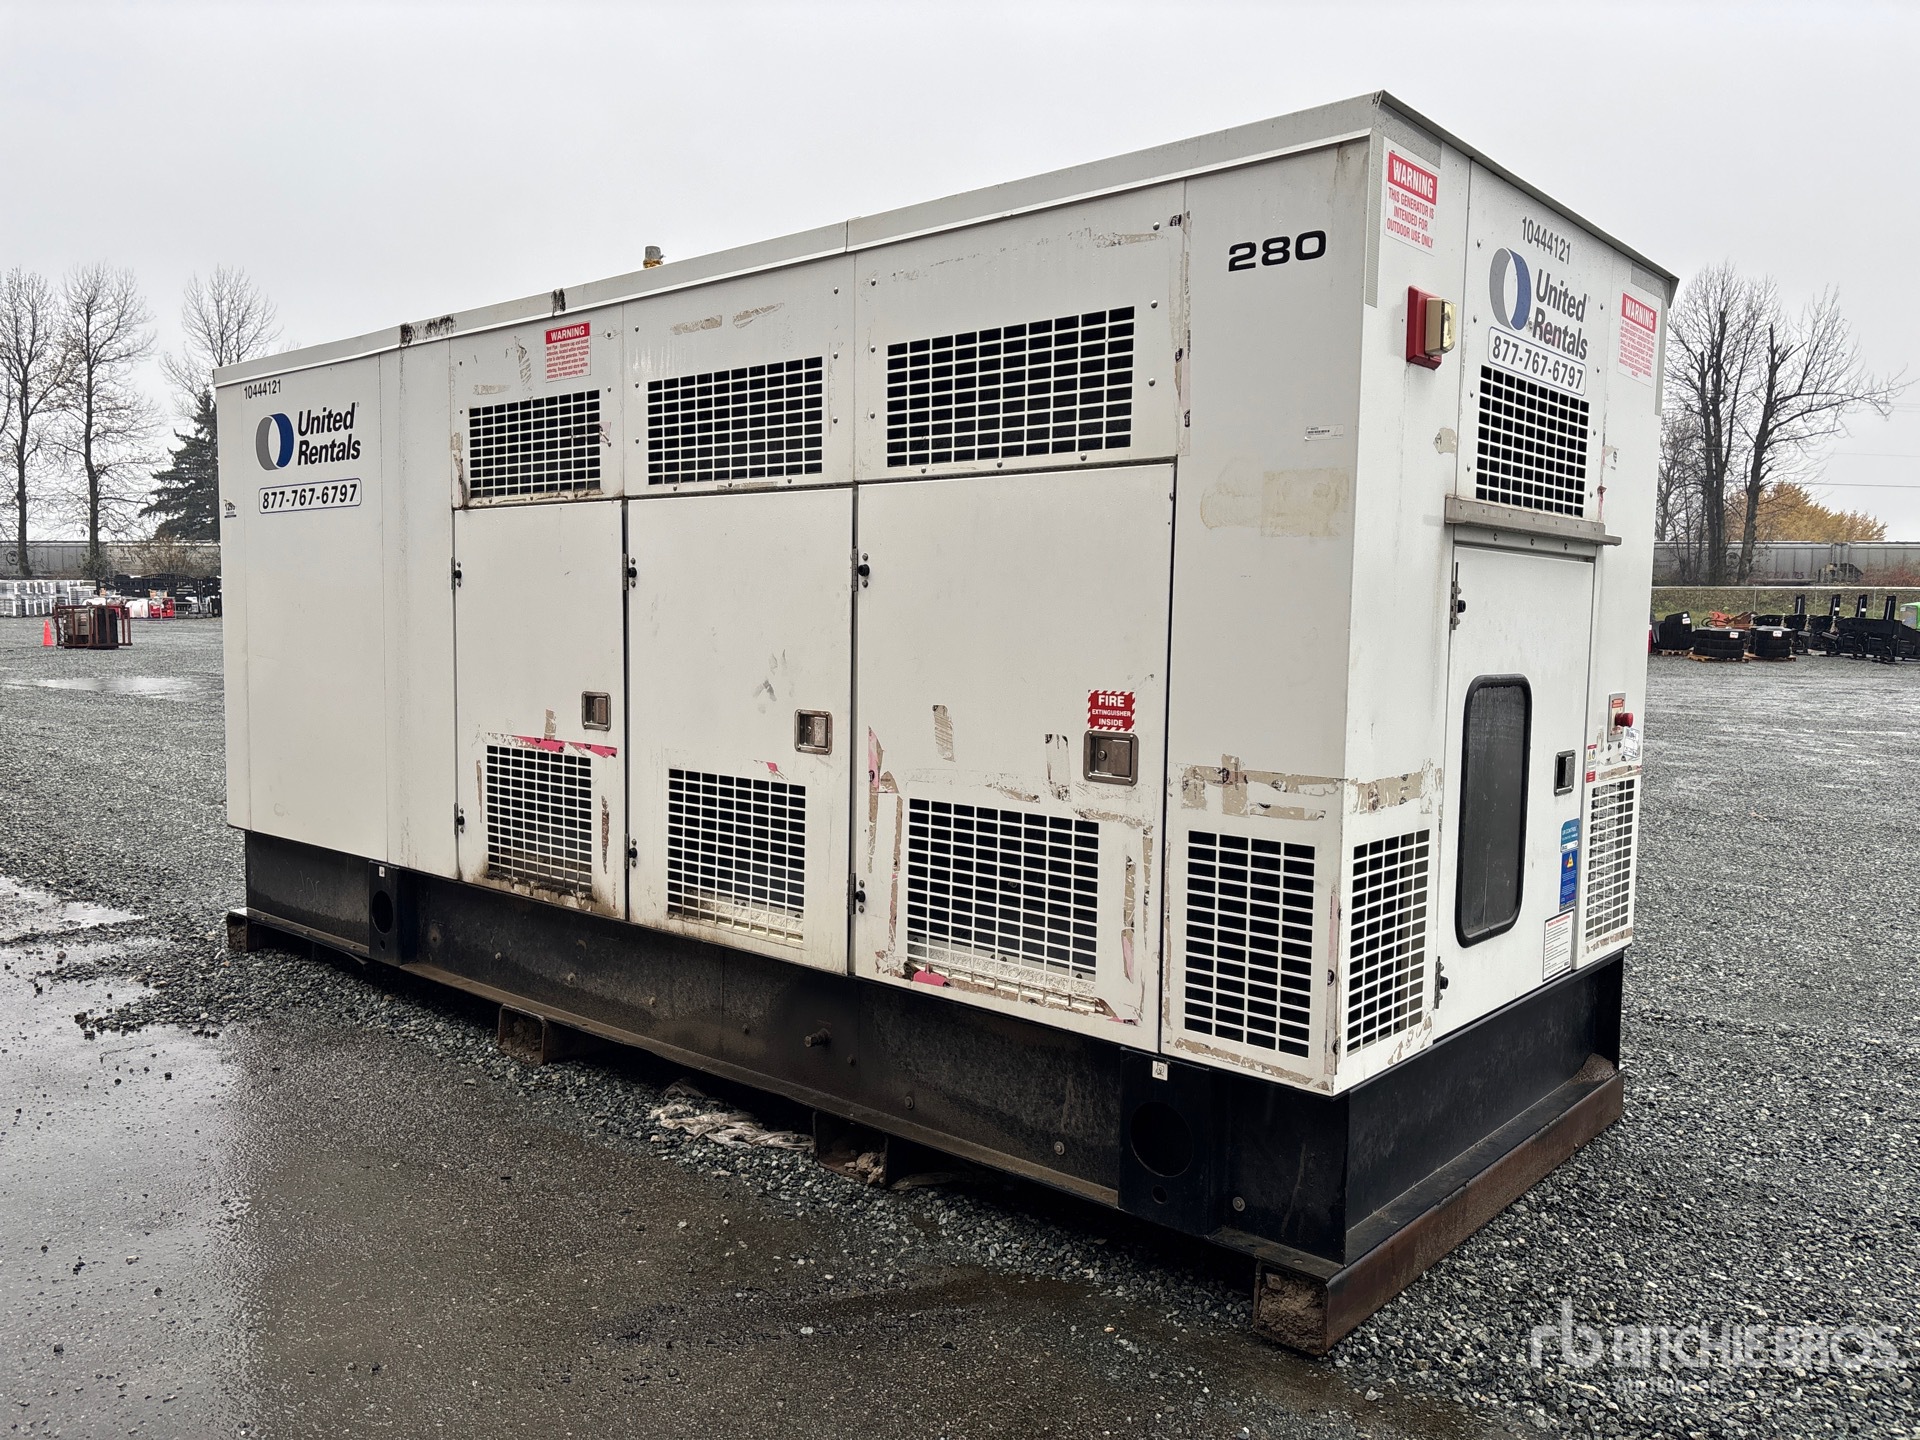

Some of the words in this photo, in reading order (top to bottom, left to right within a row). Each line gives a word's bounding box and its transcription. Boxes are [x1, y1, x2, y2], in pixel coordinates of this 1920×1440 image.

[1393, 159, 1433, 199] WARNING
[1388, 187, 1399, 203] THIS
[1401, 193, 1428, 217] GENERATOR
[1429, 208, 1434, 220] IS
[1393, 206, 1417, 227] INTENDED
[1418, 217, 1428, 231] FOR
[1387, 218, 1410, 238] OUTDOOR
[1411, 229, 1420, 243] USE
[1421, 233, 1433, 249] ONLY
[1522, 216, 1571, 264] 10444121
[1228, 230, 1326, 272] 280
[1535, 268, 1588, 323] United
[1625, 297, 1654, 330] WARNING
[550, 326, 585, 341] WARNING
[1532, 307, 1588, 360] Rentals
[1492, 335, 1584, 390] 877-767-6797
[244, 379, 281, 400] 10444121
[297, 402, 356, 437] United
[297, 433, 361, 466] Rentals
[262, 484, 358, 509] 877-767-6797
[1091, 709, 1131, 717] EXTINGUISHER
[1098, 695, 1125, 707] FIRE
[1098, 718, 1123, 727] INSIDE
